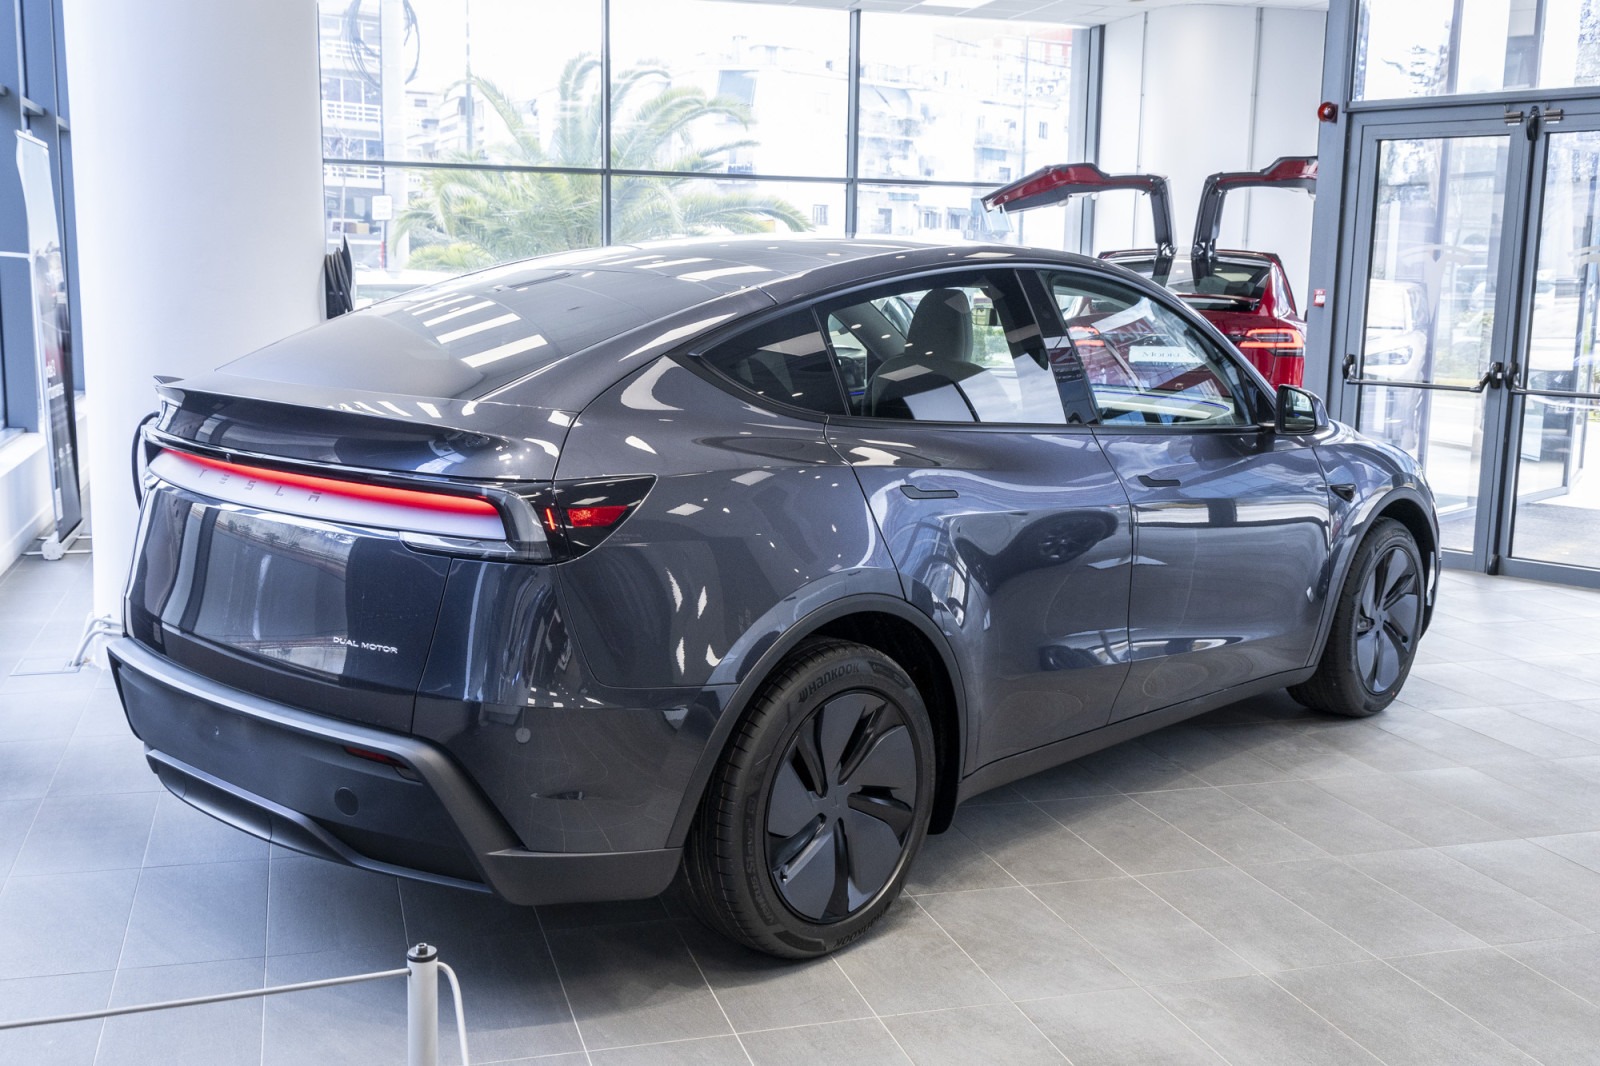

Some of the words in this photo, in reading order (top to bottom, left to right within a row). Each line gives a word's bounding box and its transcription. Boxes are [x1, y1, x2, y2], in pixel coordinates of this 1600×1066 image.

[198, 468, 322, 503] TESLA
[333, 636, 359, 648] DUAL
[361, 641, 398, 654] MOTOR
